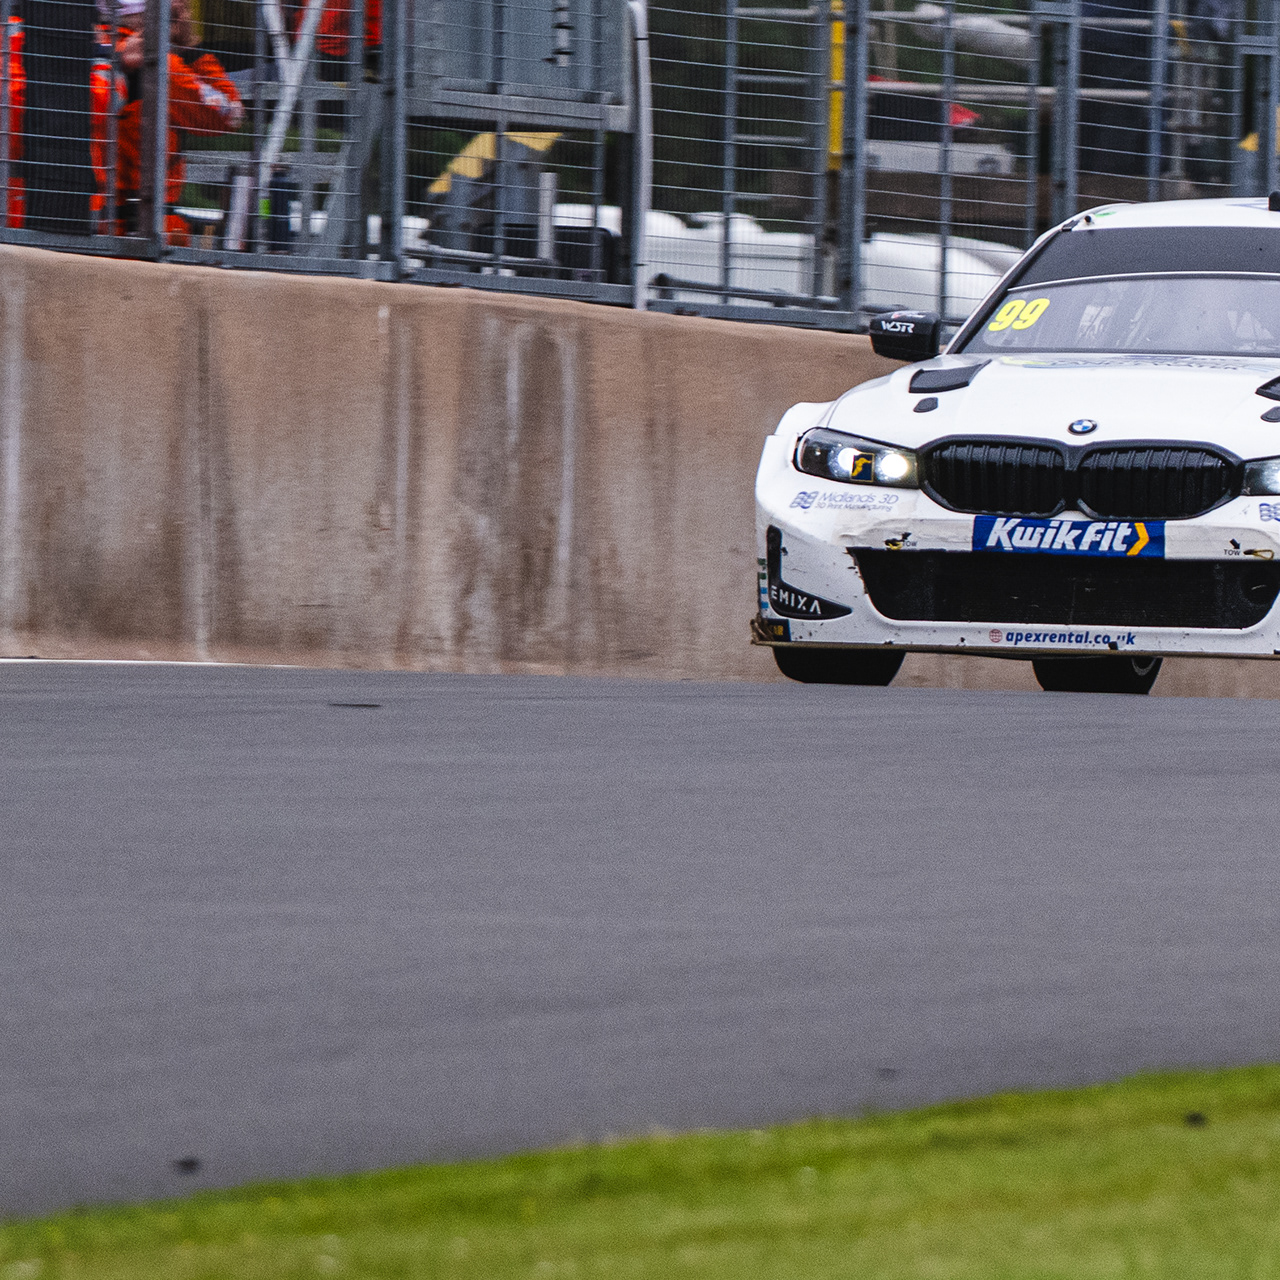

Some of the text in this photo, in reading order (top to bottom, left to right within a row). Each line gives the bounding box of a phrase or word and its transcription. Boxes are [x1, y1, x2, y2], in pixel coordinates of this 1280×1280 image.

[988, 298, 1051, 332] 99
[881, 320, 915, 334] WSR
[820, 491, 899, 505] Midlands 3D
[1224, 548, 1241, 556] TOW
[1006, 631, 1137, 645] apexrental.cok
